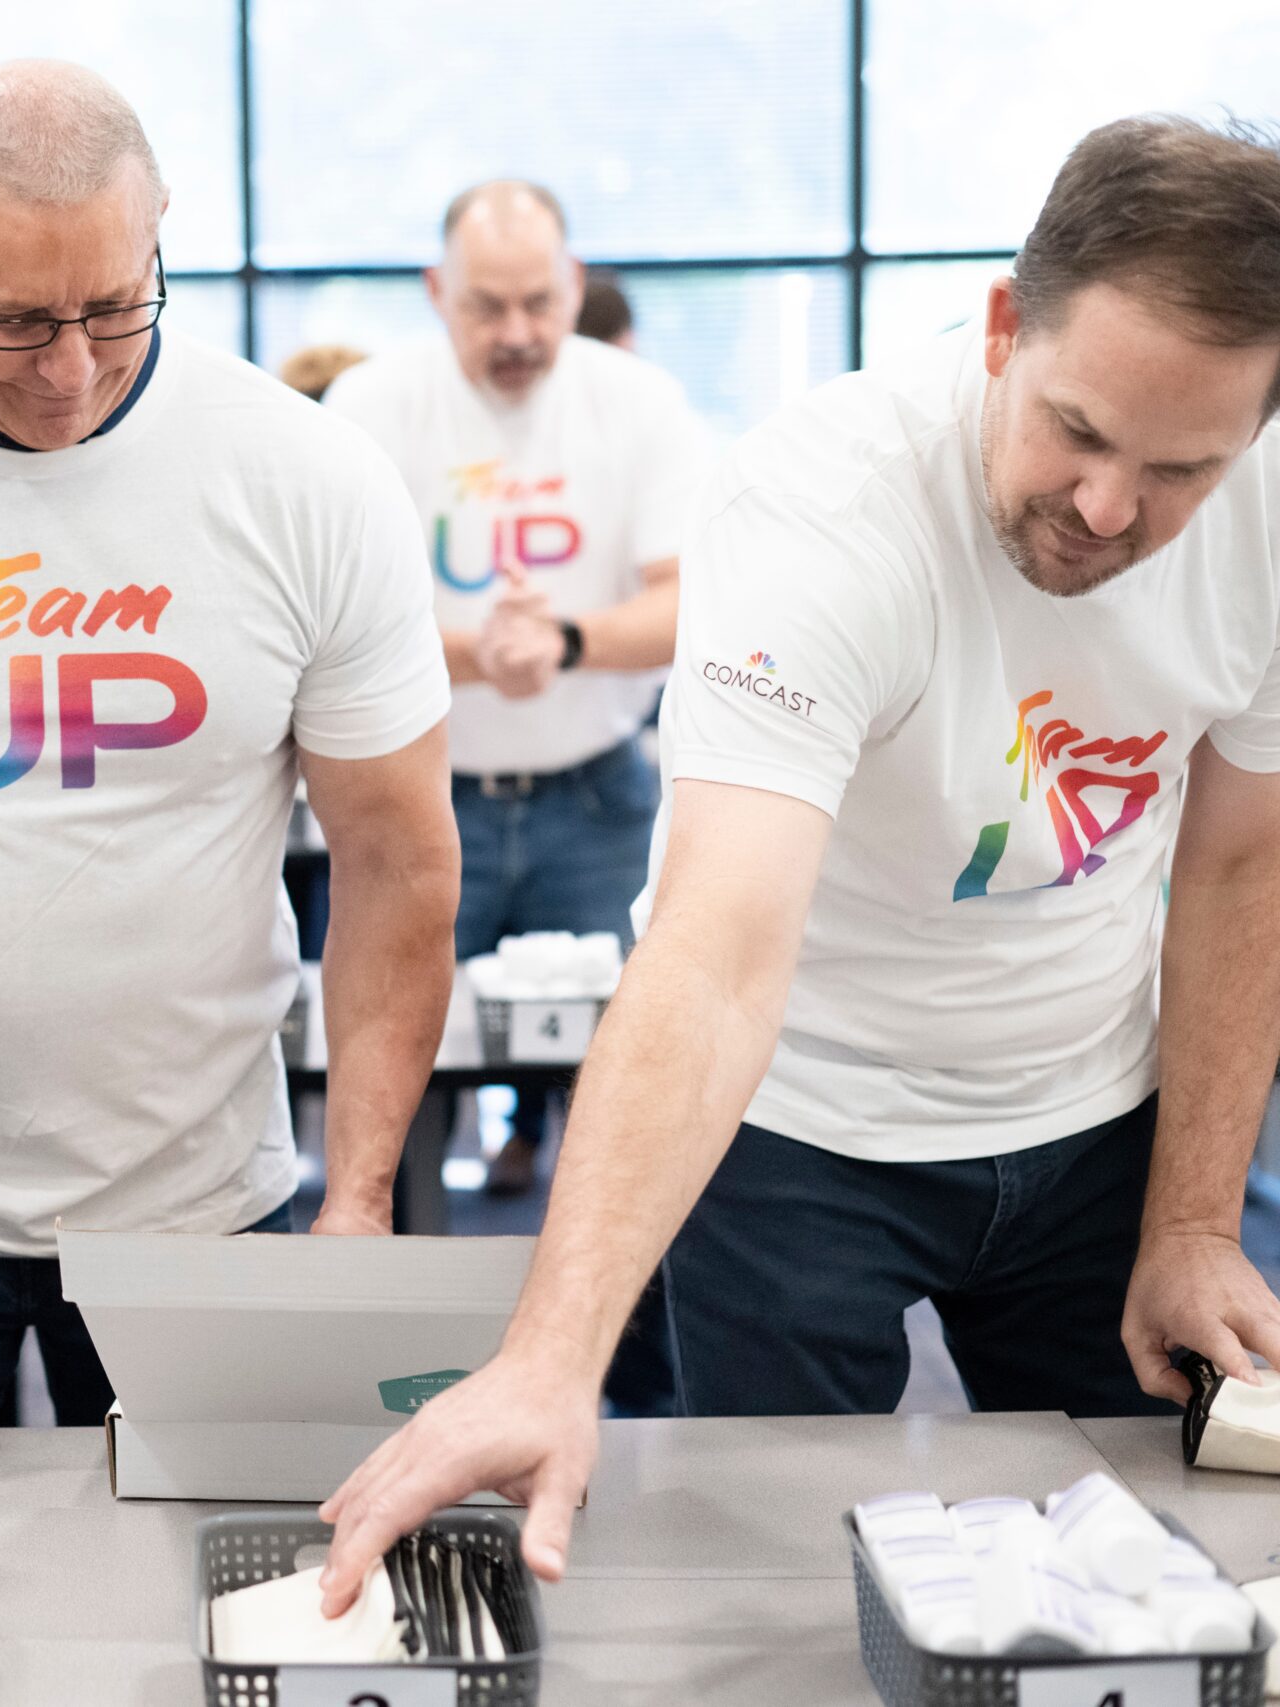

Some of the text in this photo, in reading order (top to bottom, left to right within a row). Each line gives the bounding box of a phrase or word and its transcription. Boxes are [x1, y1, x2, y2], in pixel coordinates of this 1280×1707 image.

[432, 511, 585, 596] UP
[703, 660, 818, 717] COMCAST
[538, 1012, 560, 1039] 4
